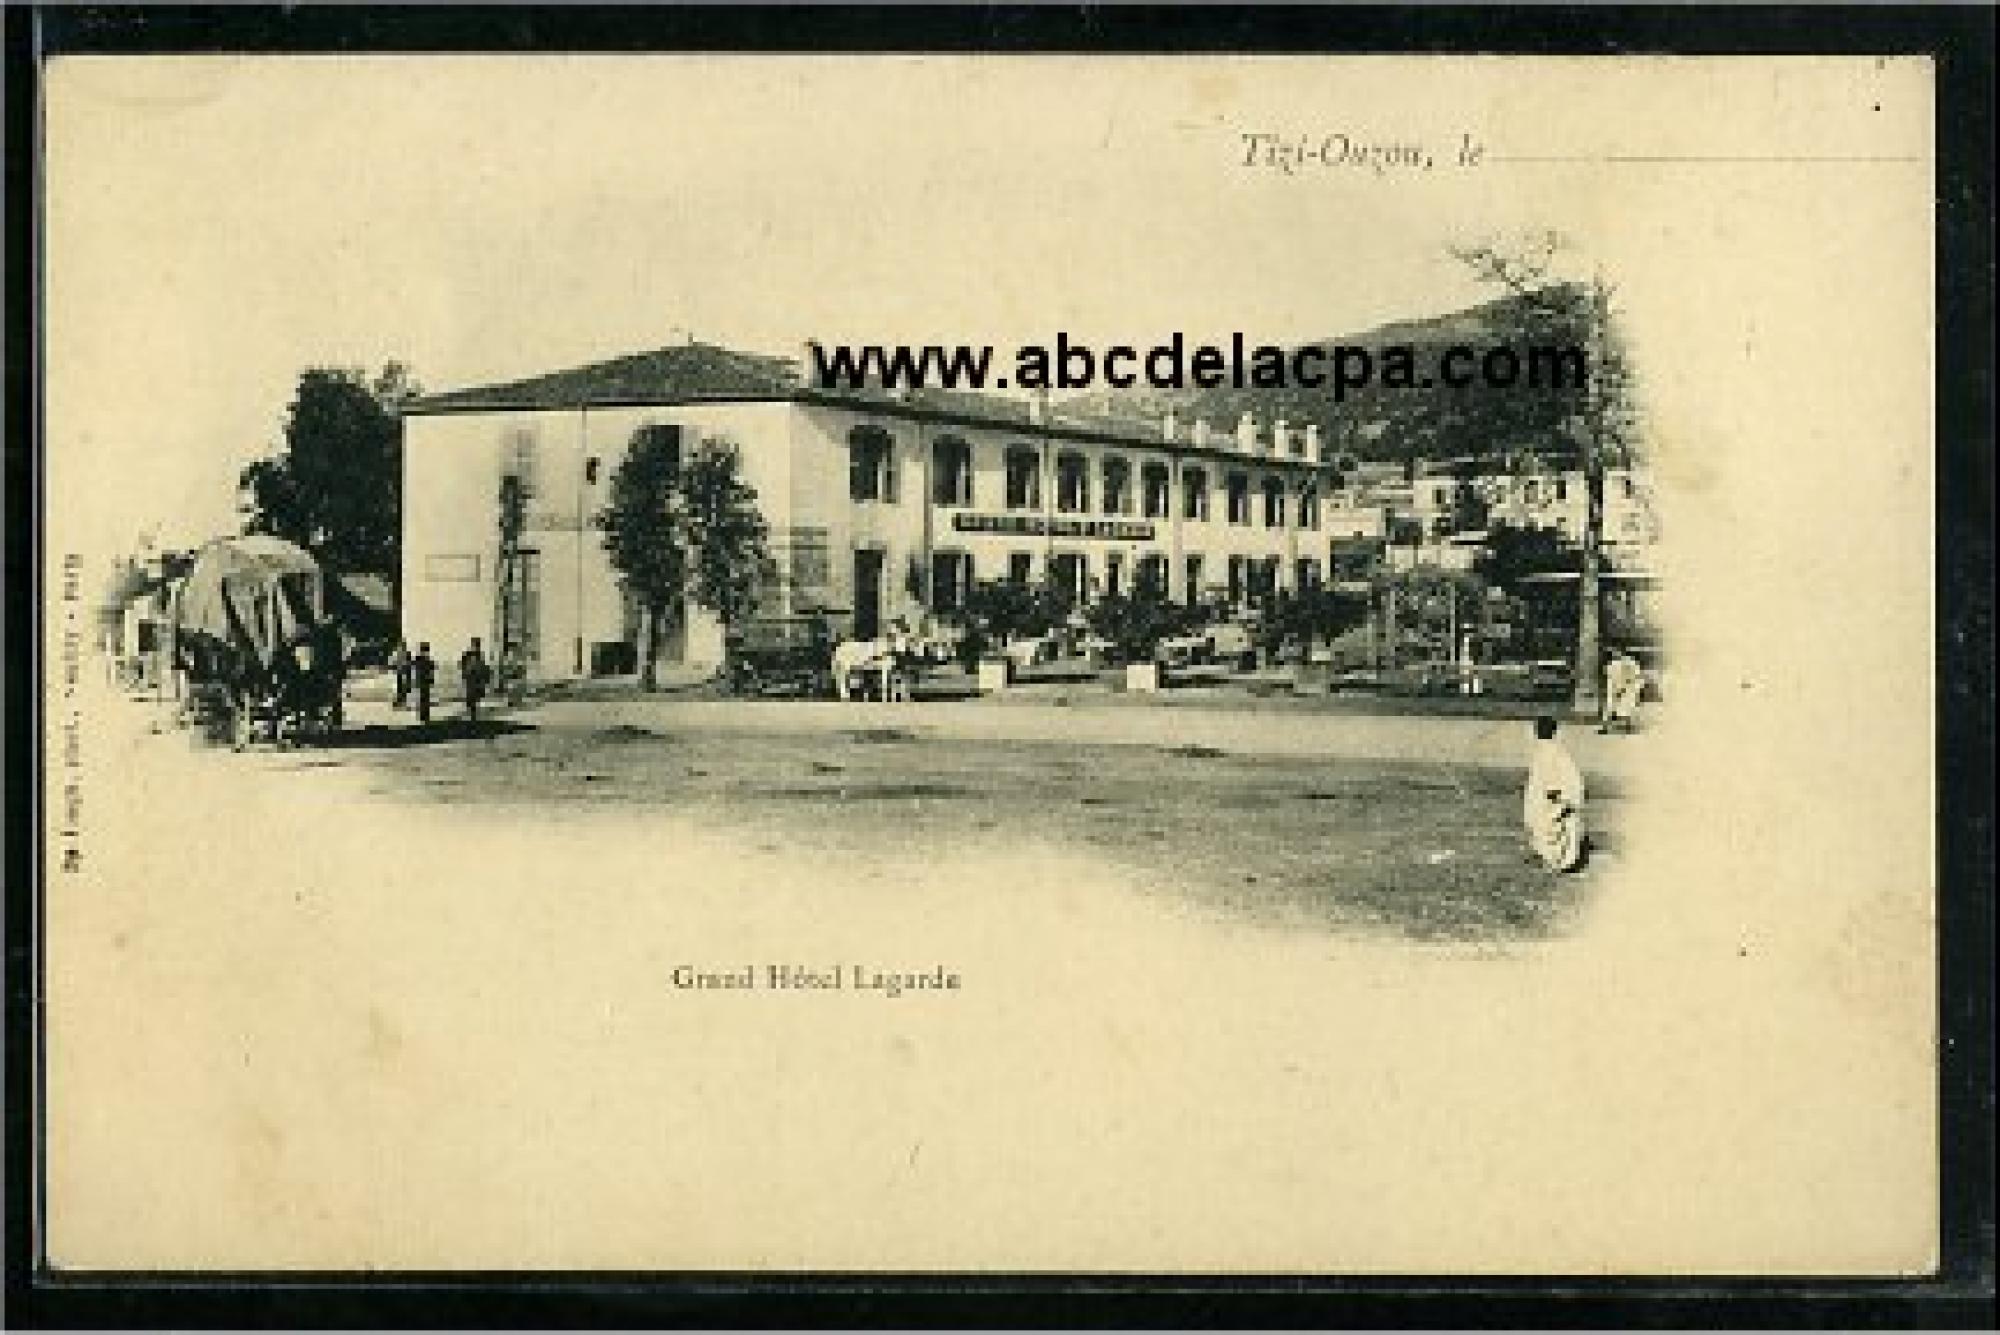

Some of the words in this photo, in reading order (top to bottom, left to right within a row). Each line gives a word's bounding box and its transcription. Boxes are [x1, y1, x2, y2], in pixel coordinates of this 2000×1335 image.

[1456, 133, 1485, 167] le
[671, 964, 754, 990] Grand
[854, 964, 961, 998] Lagarde
